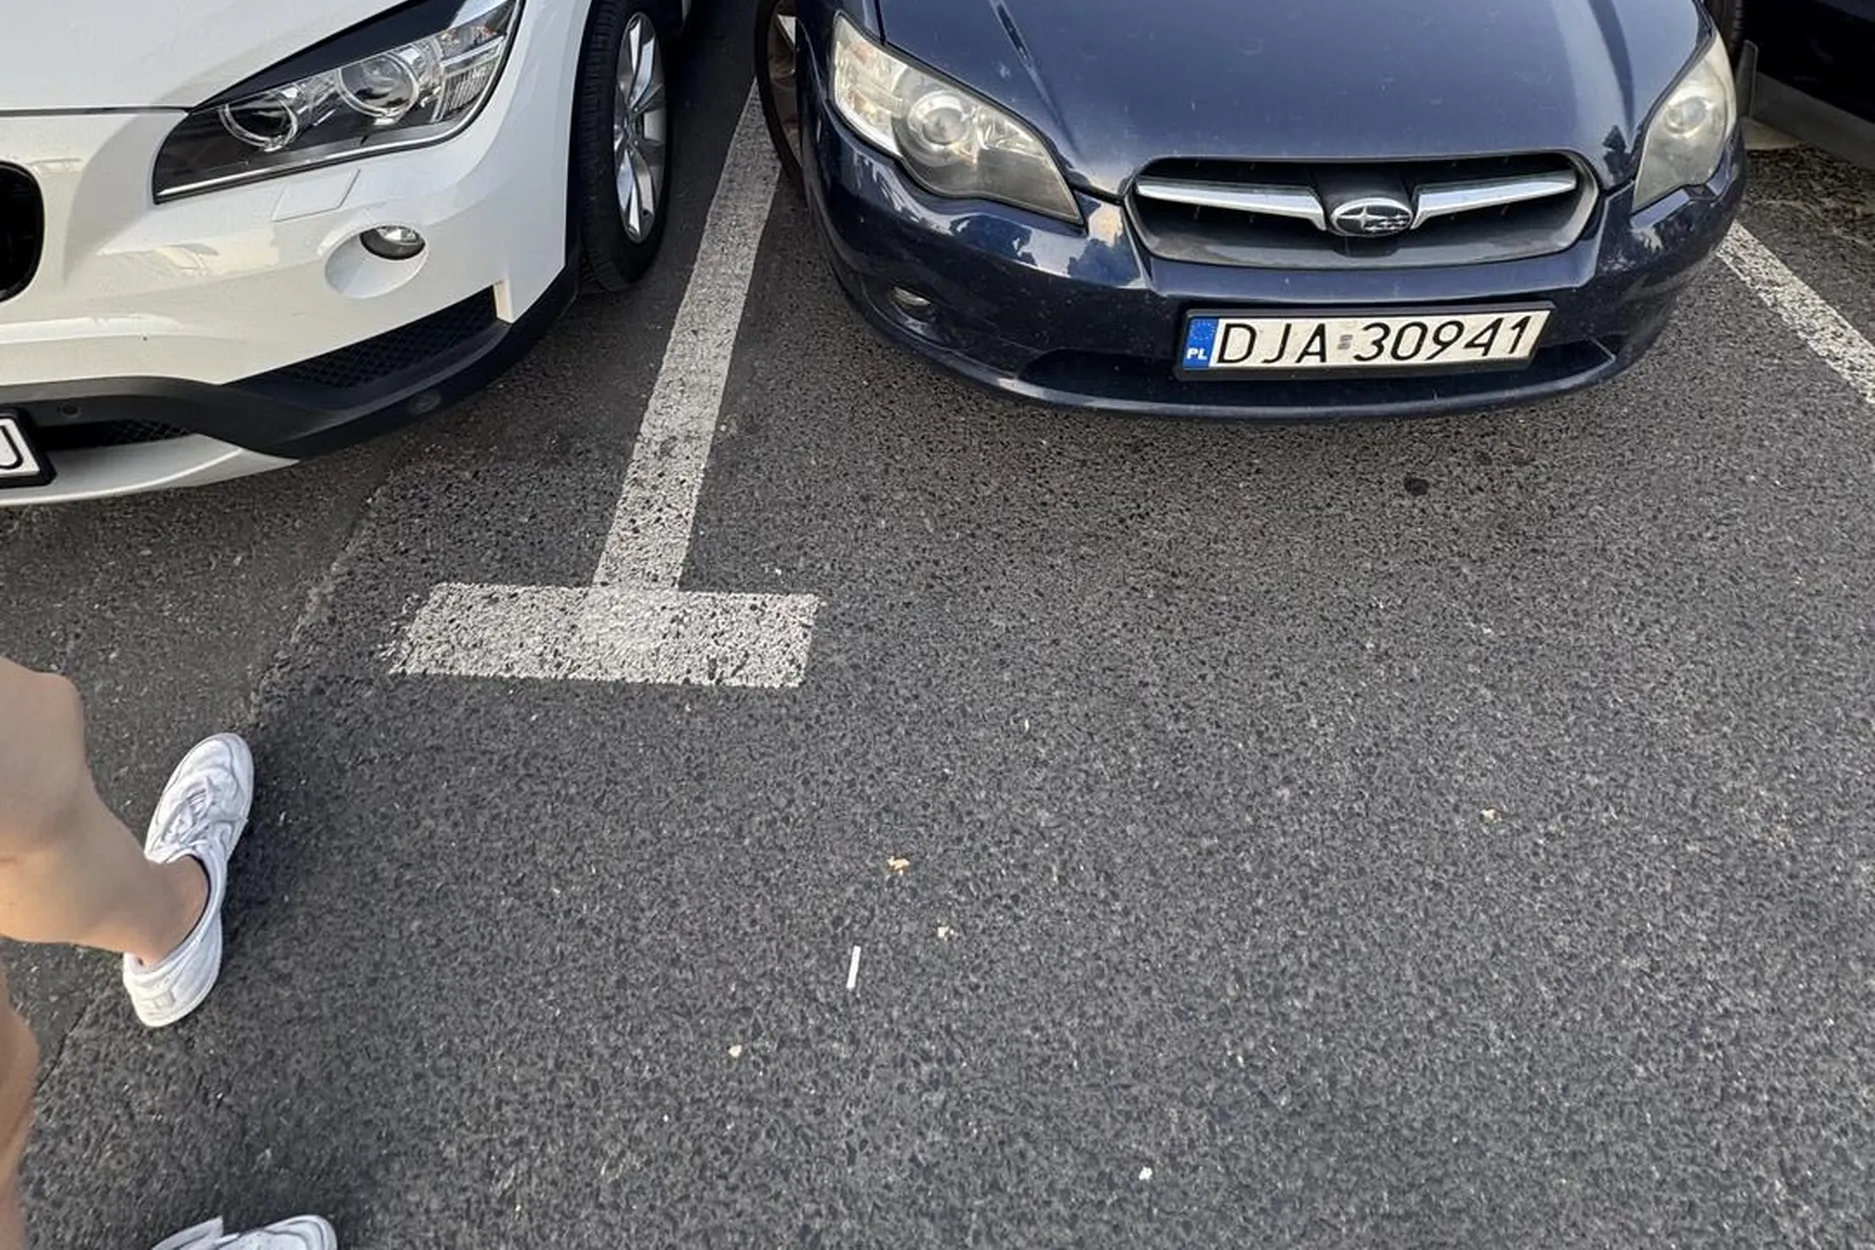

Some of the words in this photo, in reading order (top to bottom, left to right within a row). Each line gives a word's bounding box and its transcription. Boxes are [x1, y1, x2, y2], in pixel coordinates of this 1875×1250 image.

[1186, 347, 1208, 360] PL
[1217, 322, 1327, 364] DJA
[1353, 315, 1532, 362] 30941
